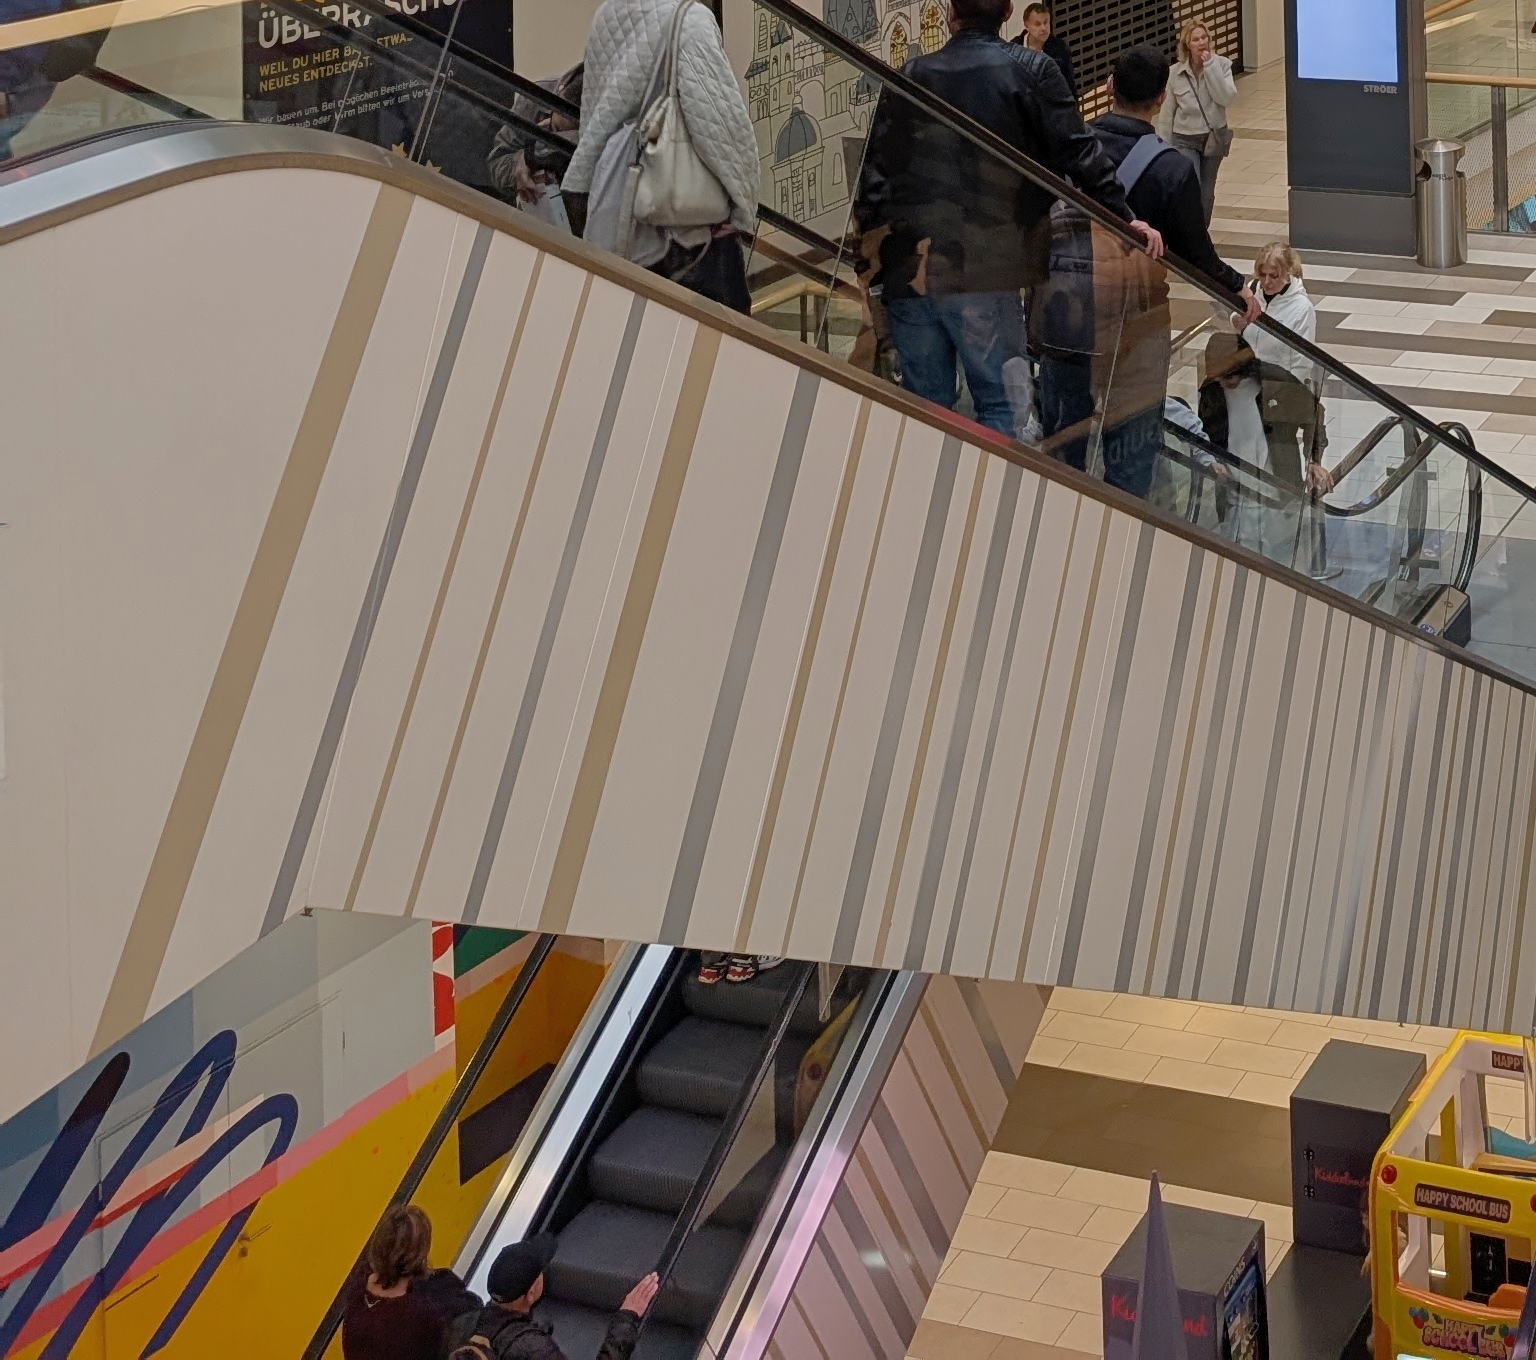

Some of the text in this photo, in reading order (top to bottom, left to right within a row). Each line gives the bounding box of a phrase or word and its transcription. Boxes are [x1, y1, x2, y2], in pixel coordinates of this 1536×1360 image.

[259, 61, 288, 77] WEIL
[292, 55, 309, 68] DU
[313, 48, 340, 64] HIER
[259, 73, 300, 93] NEUES
[1363, 84, 1398, 94] STRÖER
[1416, 1187, 1509, 1219] HAPPY SCHOOL BUS
